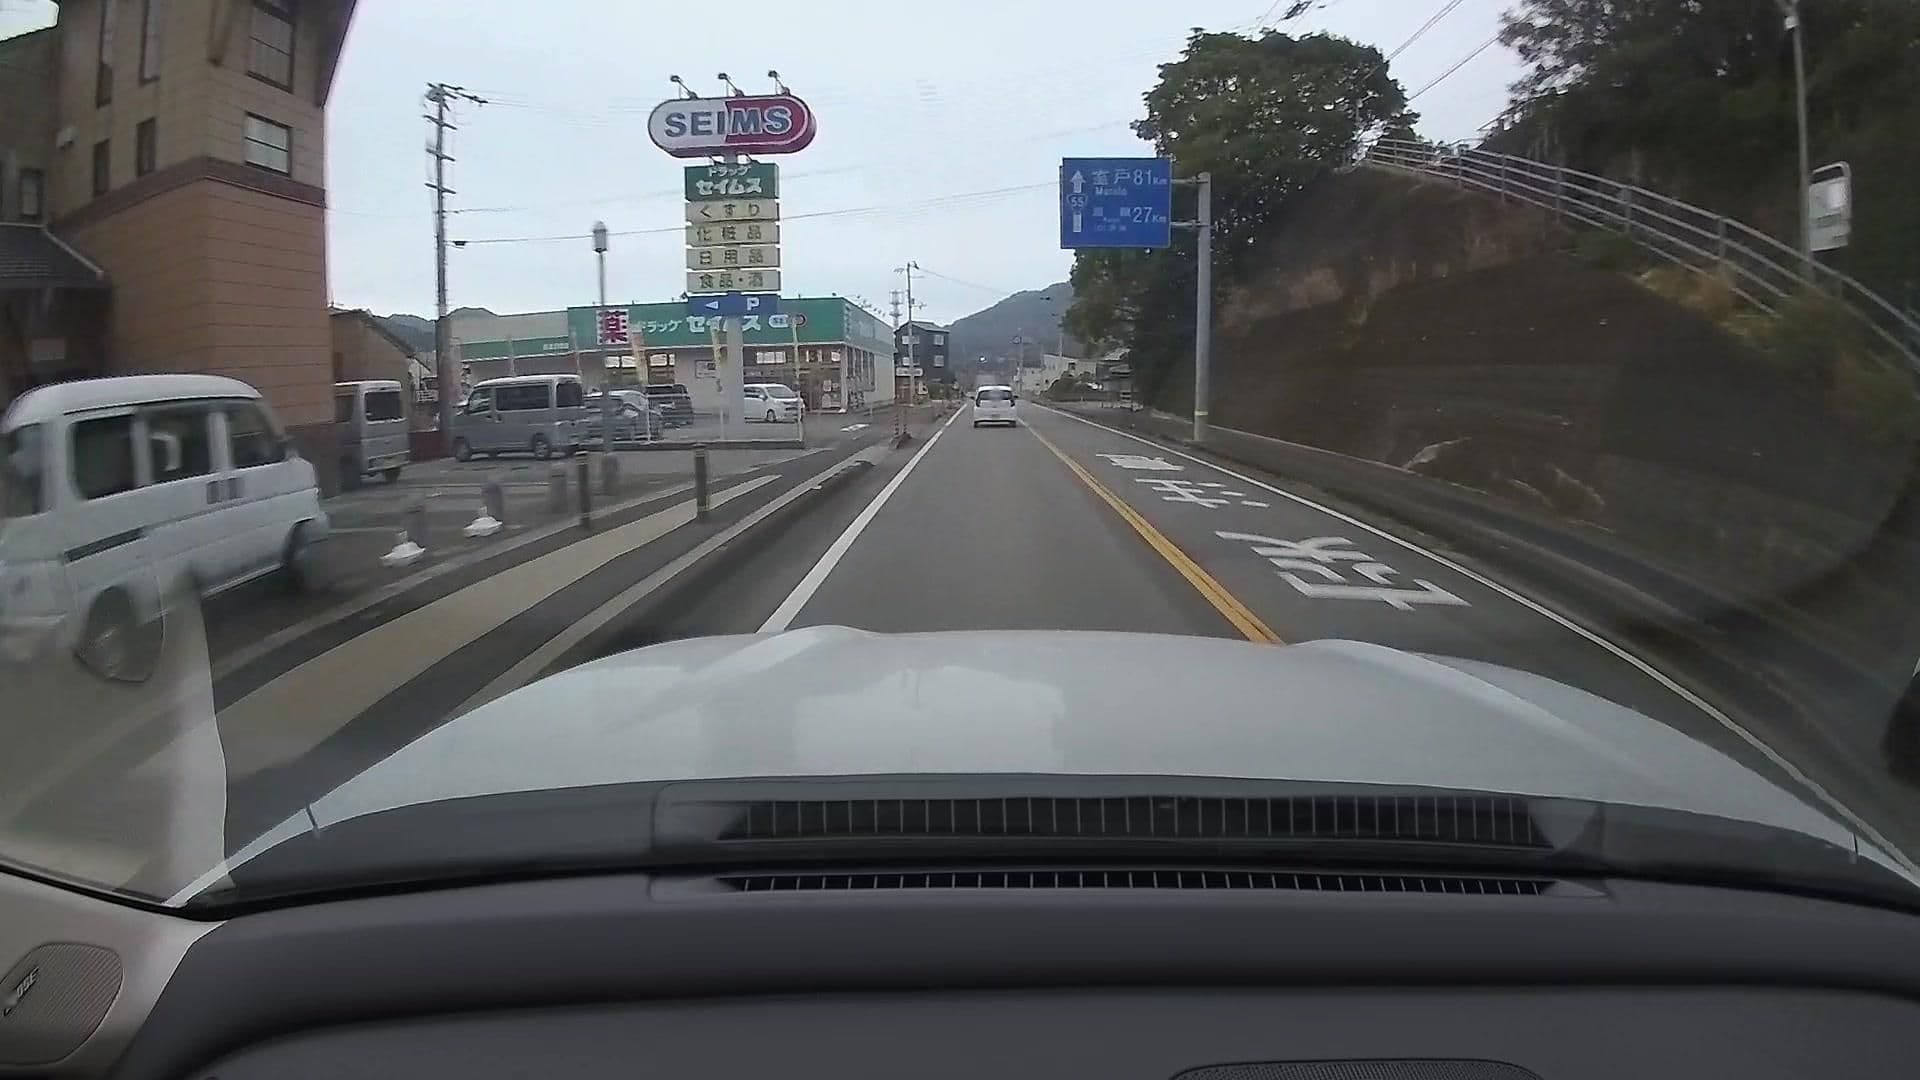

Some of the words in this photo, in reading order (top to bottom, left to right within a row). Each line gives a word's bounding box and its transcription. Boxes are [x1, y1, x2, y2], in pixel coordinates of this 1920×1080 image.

[664, 106, 793, 138] SEIMS
[1092, 168, 1131, 186] 室戸
[695, 178, 762, 196] セイムス
[1070, 196, 1085, 207] 55
[701, 203, 761, 219] くすり
[697, 225, 763, 241] 化粧品
[700, 248, 765, 265] 日用品
[746, 297, 760, 311] P
[597, 310, 628, 344] 薬
[685, 314, 761, 334] セイス
